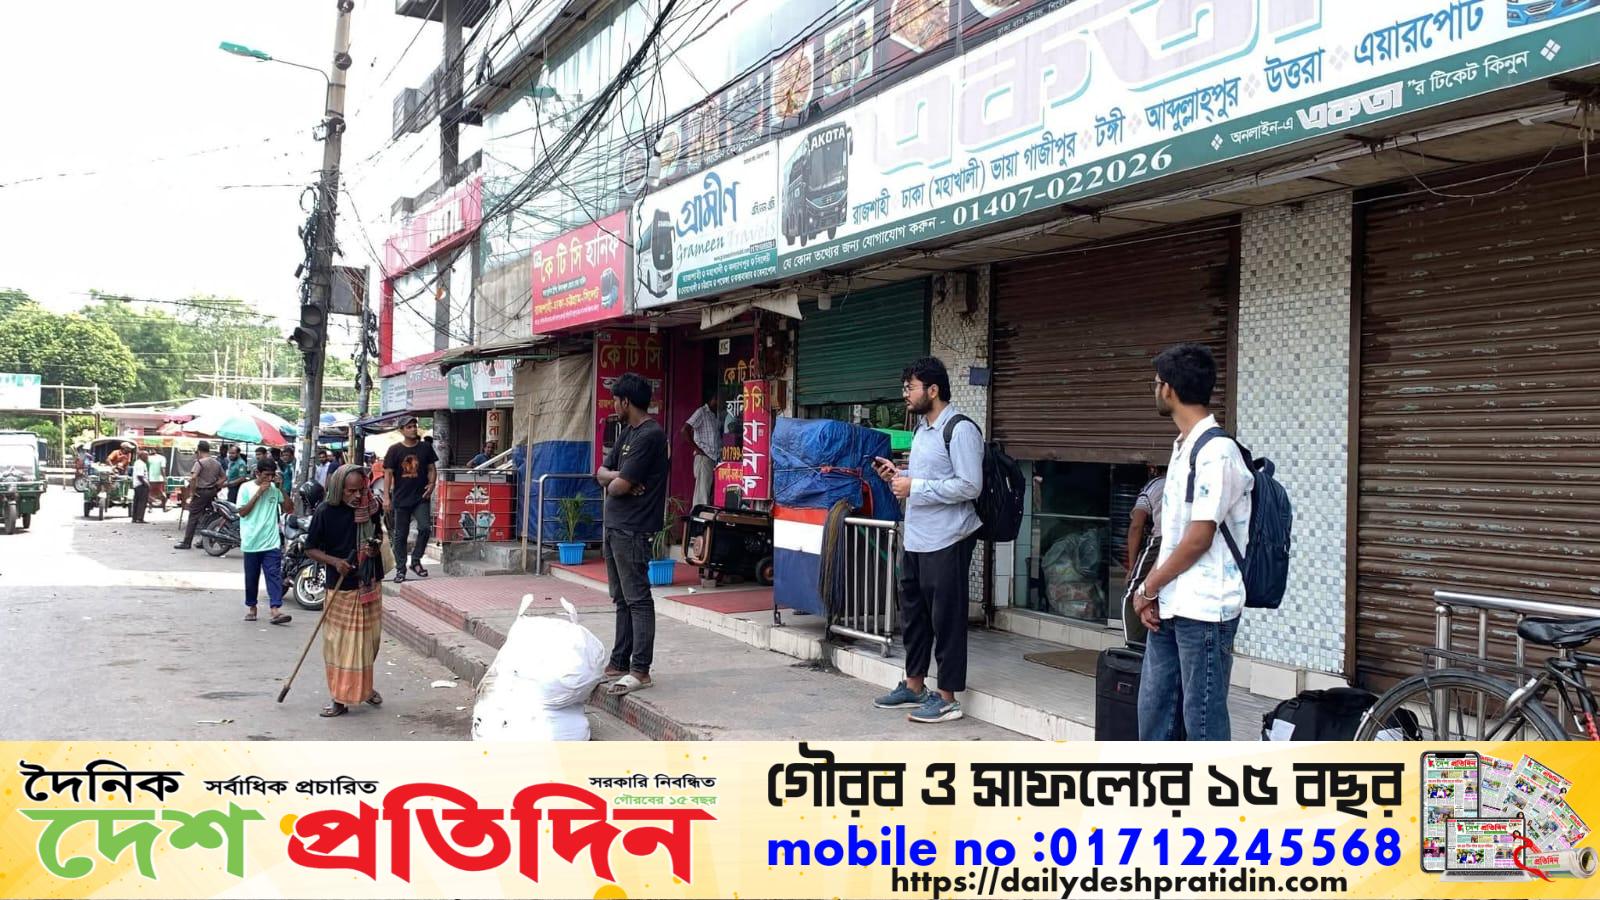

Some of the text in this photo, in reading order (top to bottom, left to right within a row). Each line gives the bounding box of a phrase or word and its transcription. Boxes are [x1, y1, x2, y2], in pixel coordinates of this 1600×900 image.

[1430, 61, 1479, 93] টিকেট
[1483, 49, 1531, 78] কিনুন
[811, 127, 849, 150] AKOTA
[852, 187, 891, 225] রাজশাহী
[901, 183, 926, 209] ঢাকা
[928, 156, 986, 208] (মহাখালী)
[990, 149, 1019, 180] ভায়া
[1023, 130, 1077, 171] গাজীপুর
[1094, 107, 1125, 149] টঙ্গী
[1263, 47, 1326, 94] উত্তরা
[676, 171, 741, 238] গ্রামীণ
[783, 258, 793, 271] যে
[793, 252, 812, 269] কোন
[814, 244, 840, 263] তথ্যের
[842, 238, 860, 255] জন্য
[862, 225, 906, 249] যোগাযোগ
[908, 216, 937, 235] করুন
[953, 144, 1173, 227] 01407-022026
[675, 234, 725, 269] Grameen
[600, 336, 663, 369] কে টি সি
